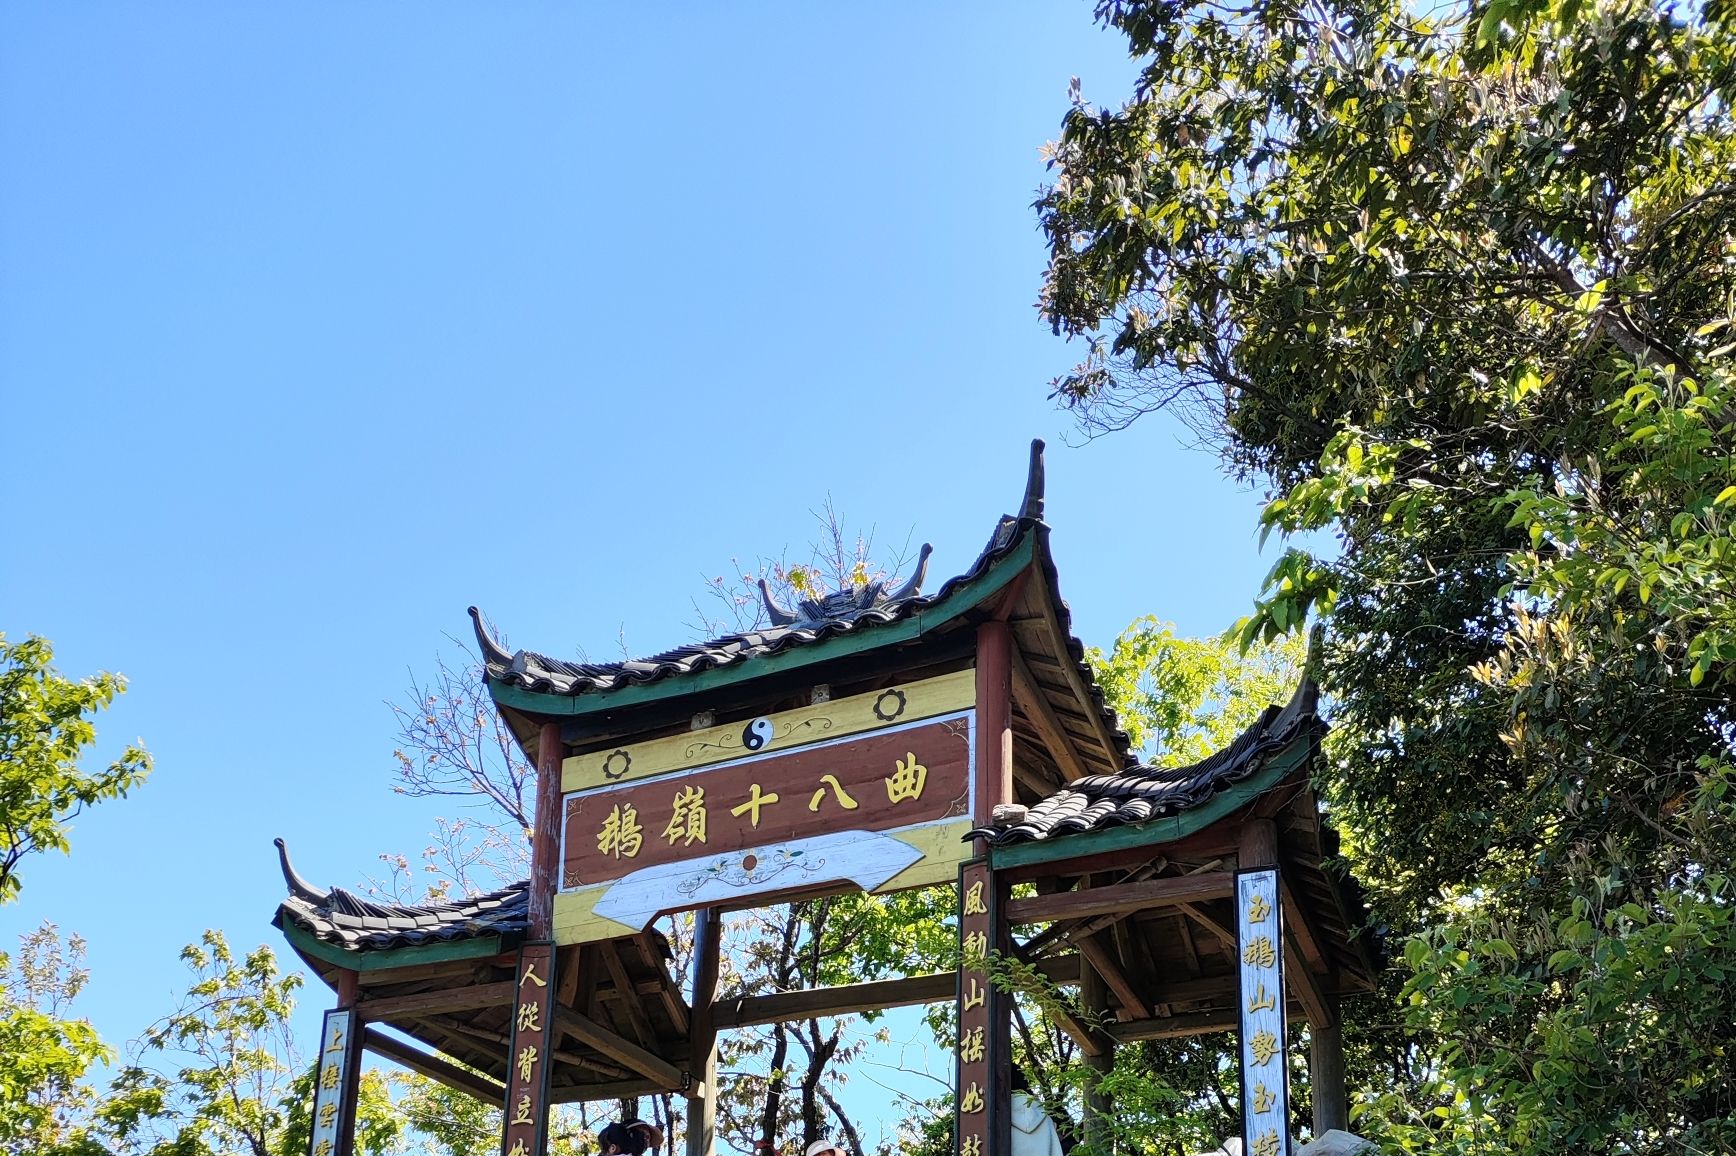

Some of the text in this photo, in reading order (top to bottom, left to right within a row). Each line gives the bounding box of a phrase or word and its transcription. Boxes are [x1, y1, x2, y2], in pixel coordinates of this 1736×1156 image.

[596, 751, 928, 860] 鵝嶺十八曲
